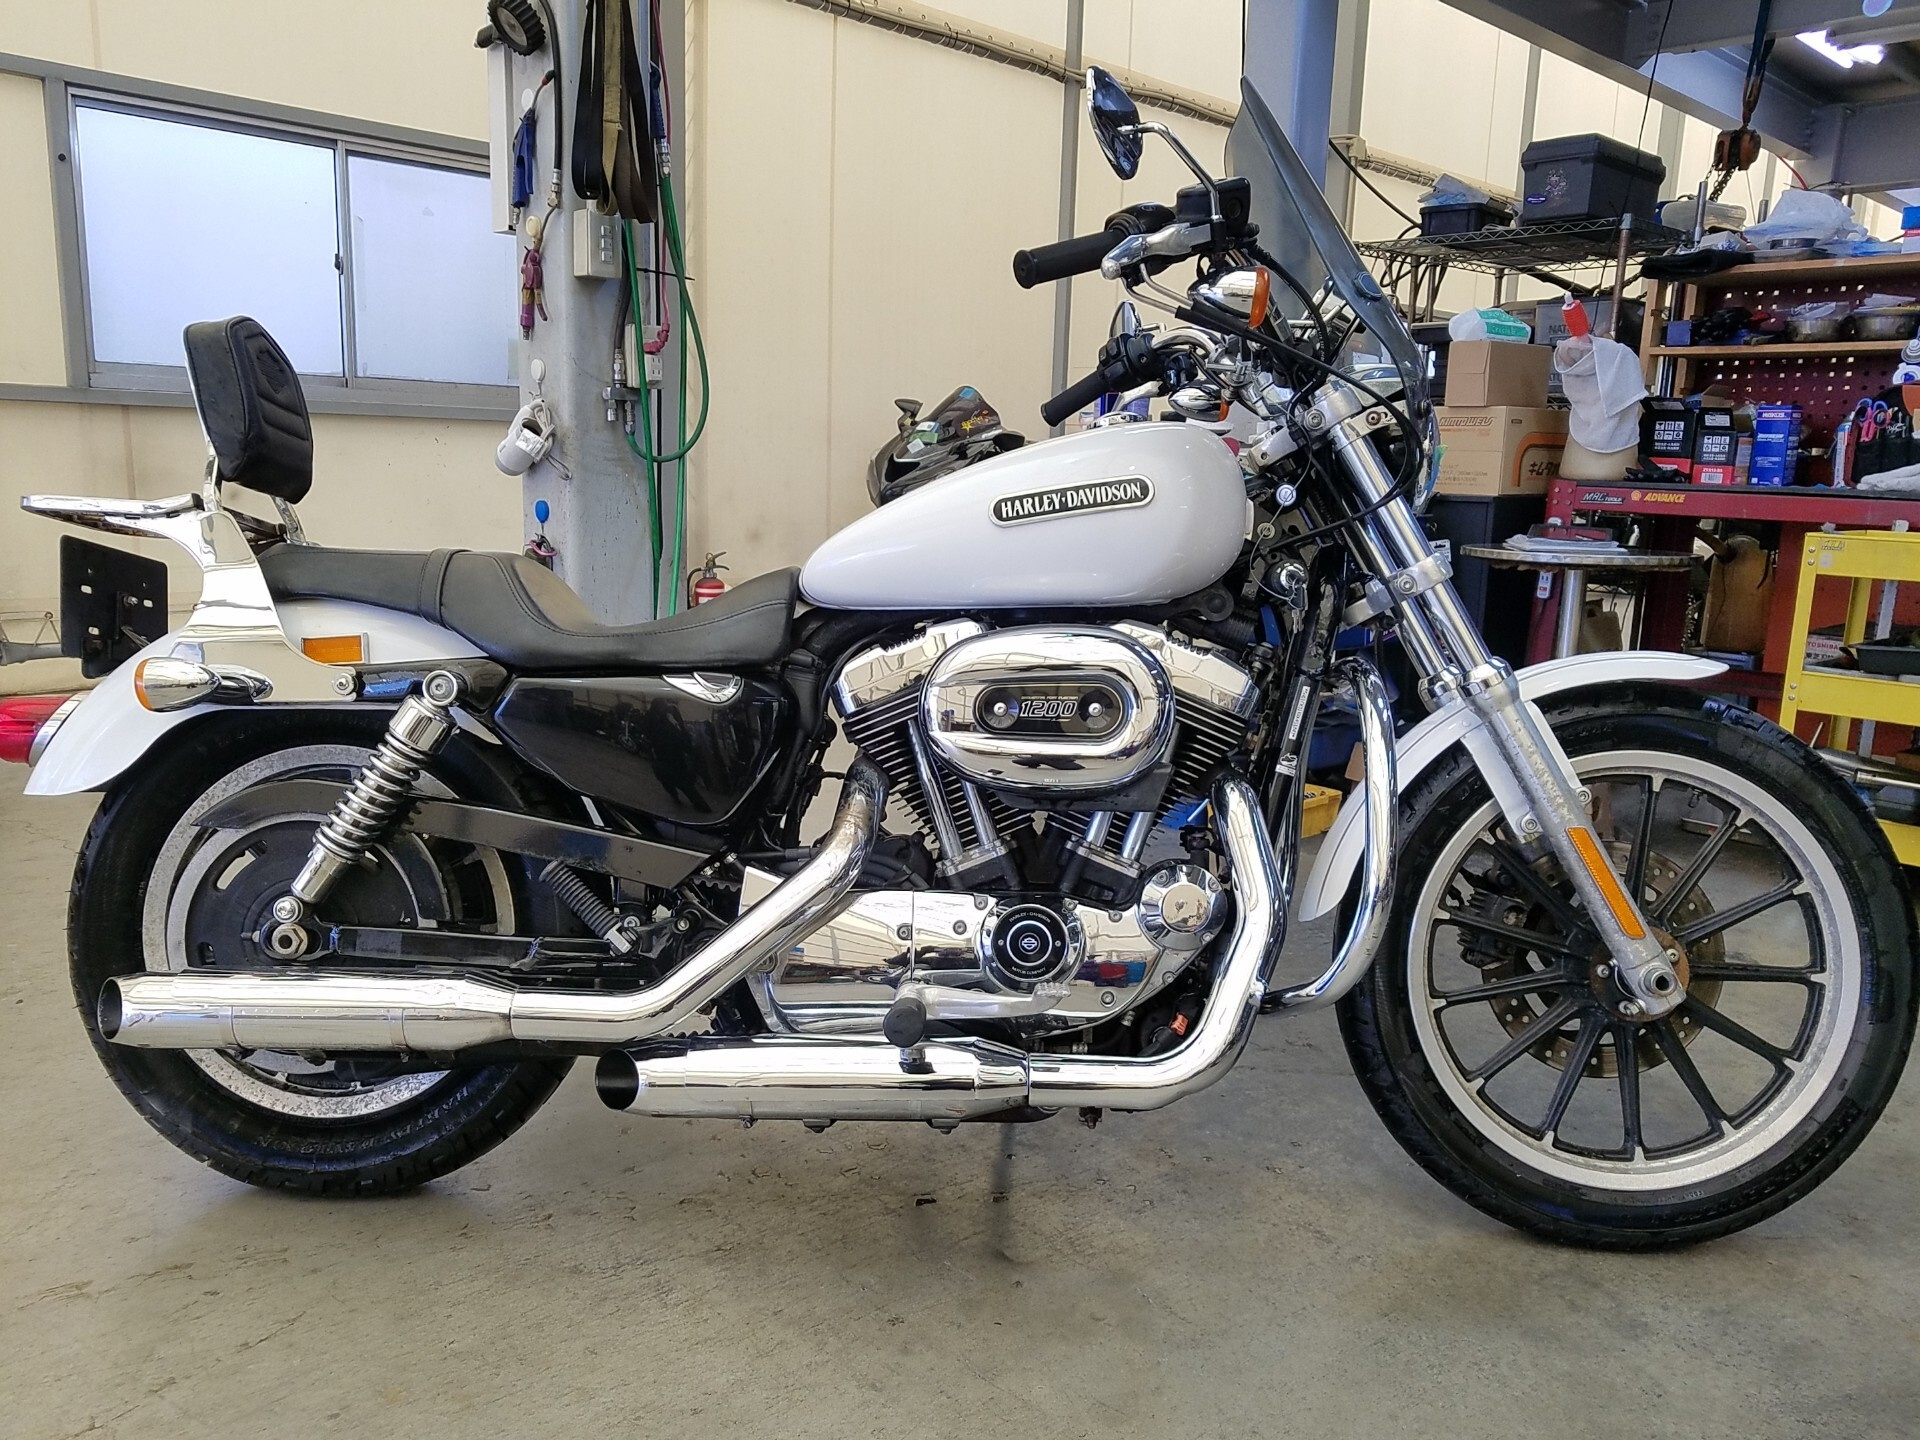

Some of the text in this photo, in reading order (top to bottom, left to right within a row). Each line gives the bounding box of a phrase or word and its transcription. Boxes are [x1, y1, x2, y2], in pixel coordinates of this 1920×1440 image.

[1643, 492, 1686, 503] ADVANCE
[1807, 641, 1839, 650] TOSHIBA
[1020, 700, 1078, 717] 1200
